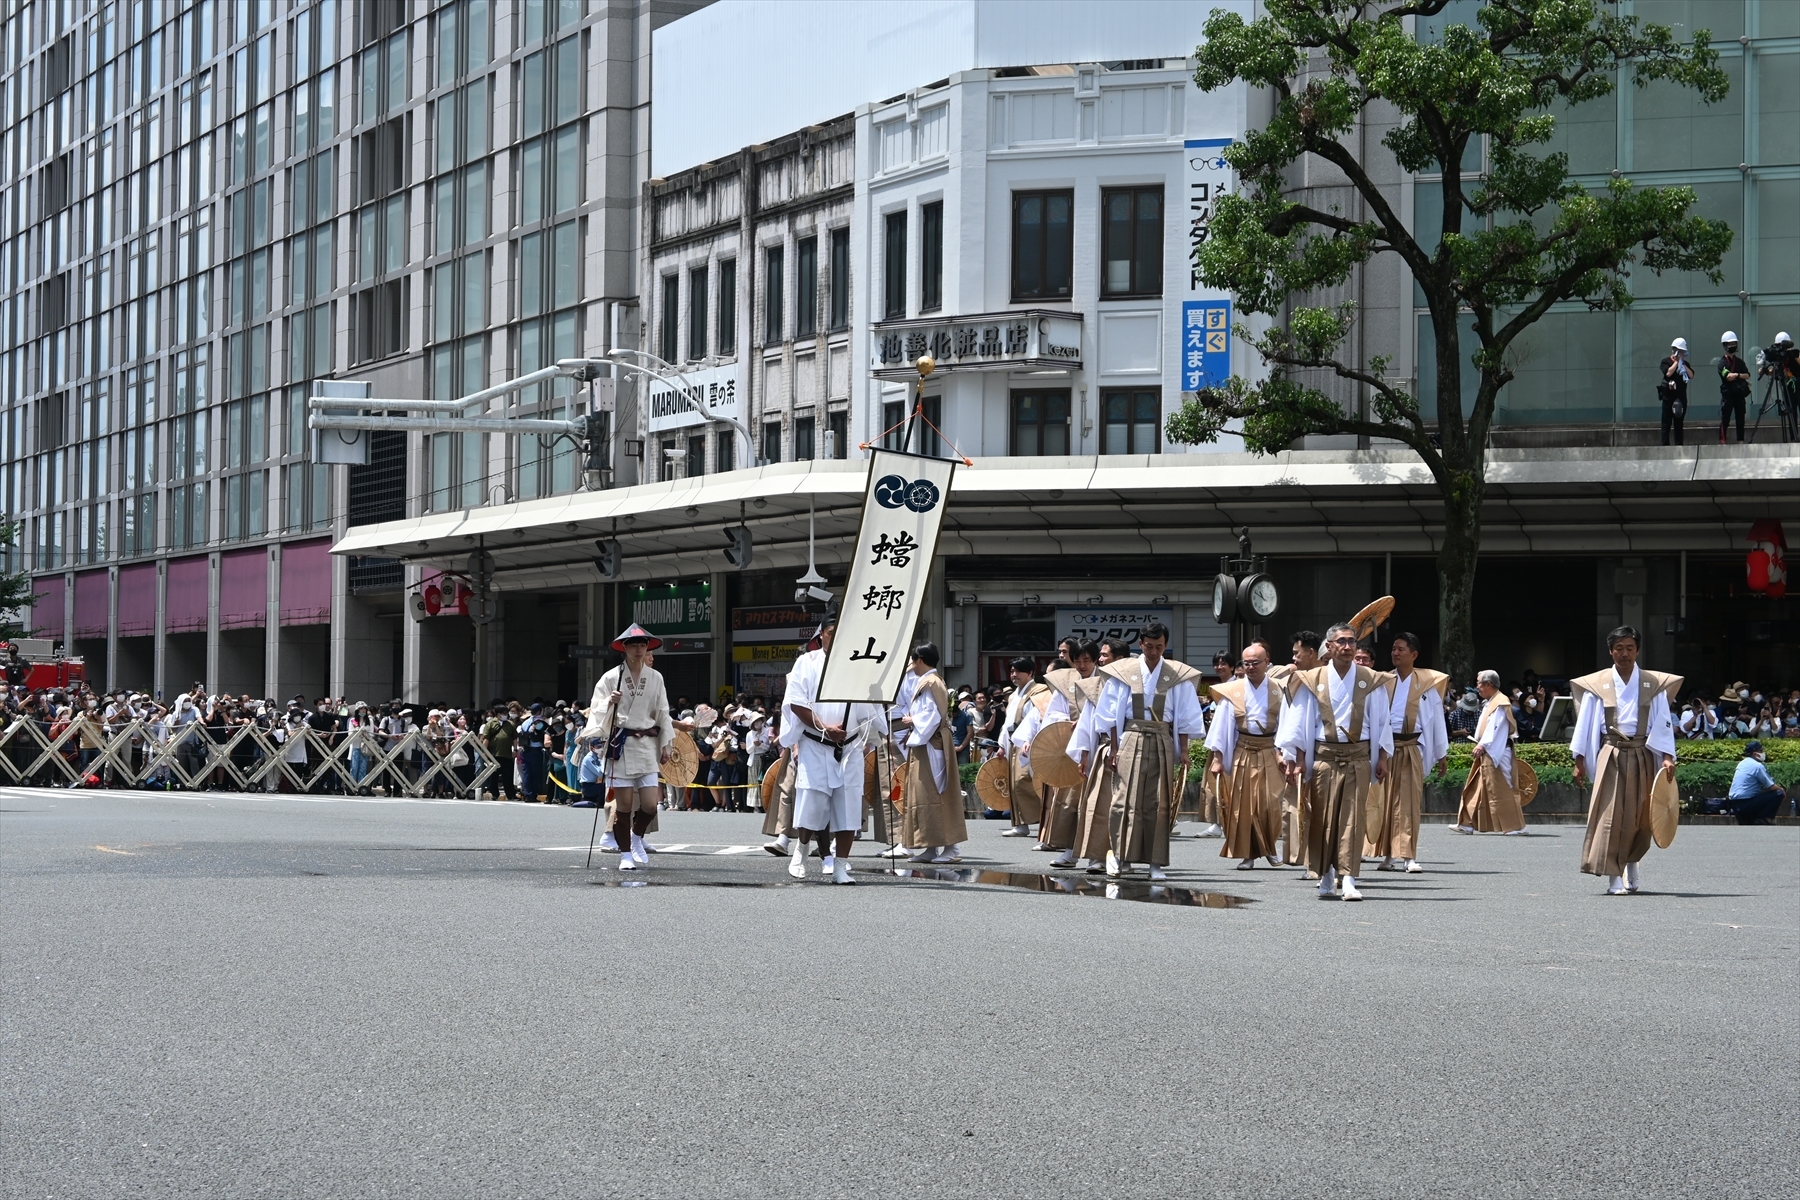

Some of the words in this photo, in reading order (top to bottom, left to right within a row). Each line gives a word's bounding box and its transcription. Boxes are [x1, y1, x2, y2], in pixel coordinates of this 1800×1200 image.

[880, 324, 1028, 364] 池善化粧品店
[1208, 310, 1224, 350] すぐ
[1187, 309, 1205, 388] 買えます
[709, 378, 736, 408] 雲の茶
[688, 596, 711, 622] 雲の茶
[849, 530, 919, 664] 蟷螂山
[633, 598, 683, 625] MARUMARU
[745, 610, 811, 625] アクセスチケット
[1100, 614, 1159, 623] メガネスーパー
[752, 646, 769, 660] Money
